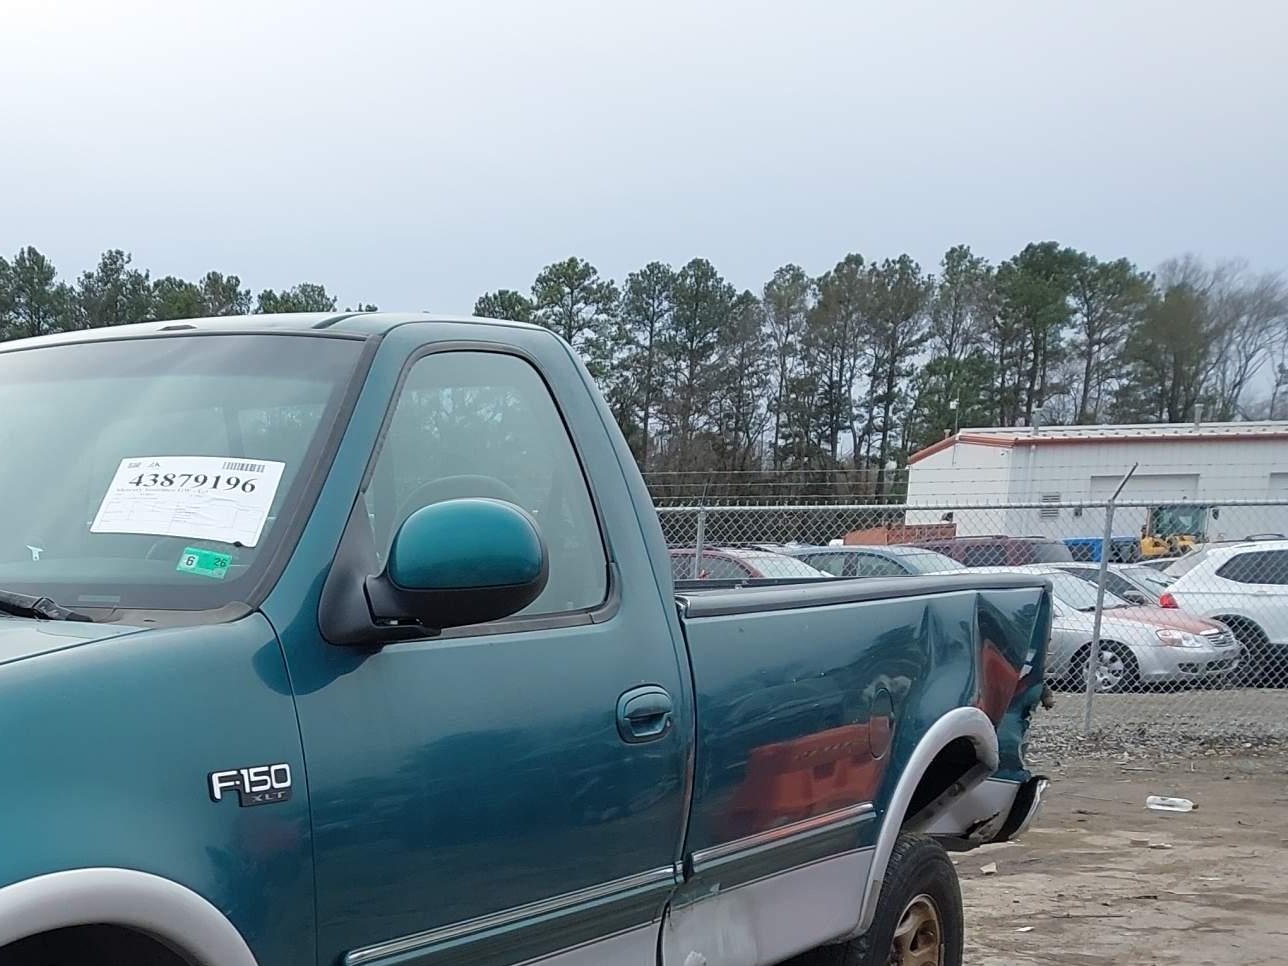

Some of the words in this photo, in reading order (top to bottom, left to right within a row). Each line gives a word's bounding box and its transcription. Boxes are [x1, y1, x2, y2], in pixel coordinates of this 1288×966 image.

[129, 472, 258, 494] 43879196
[186, 556, 196, 567] 6
[214, 557, 228, 568] 26
[251, 790, 286, 802] XLT
